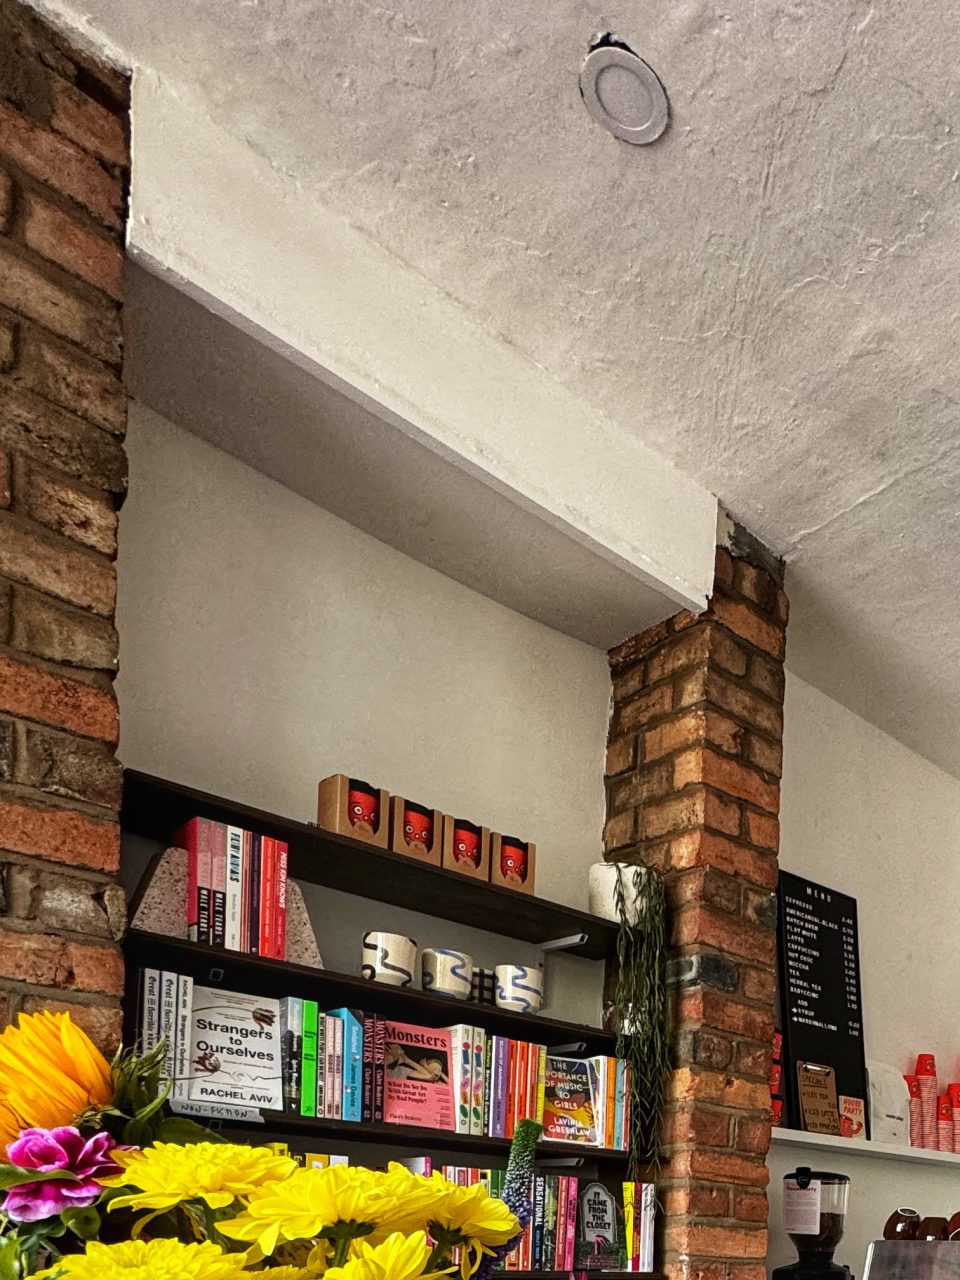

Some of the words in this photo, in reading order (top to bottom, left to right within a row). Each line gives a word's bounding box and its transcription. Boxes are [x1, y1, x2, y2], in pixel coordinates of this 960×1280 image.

[787, 933, 805, 944] LATTE
[789, 969, 800, 977] TEA
[789, 978, 810, 989] HERBAL
[196, 1018, 273, 1041] Strangers
[229, 1036, 242, 1046] to
[374, 1020, 385, 1065] MONSTERS
[385, 1027, 448, 1049] Monsters
[196, 1040, 274, 1061] Ourselves
[552, 1061, 567, 1069] THE
[545, 1080, 555, 1088] OF
[557, 1082, 582, 1091] MUSIC
[200, 1087, 247, 1100] RACHEL
[249, 1094, 273, 1104] AVIV
[559, 1092, 570, 1100] TO
[554, 1101, 578, 1110] GIRLS
[554, 1117, 583, 1127] LAVINIA
[549, 1125, 591, 1136] GREENLAW
[534, 1176, 545, 1226] SENSATIONAL
[588, 1199, 608, 1207] CAME
[588, 1206, 608, 1215] FROM
[593, 1214, 605, 1222] THE
[585, 1221, 612, 1230] CLOSET
